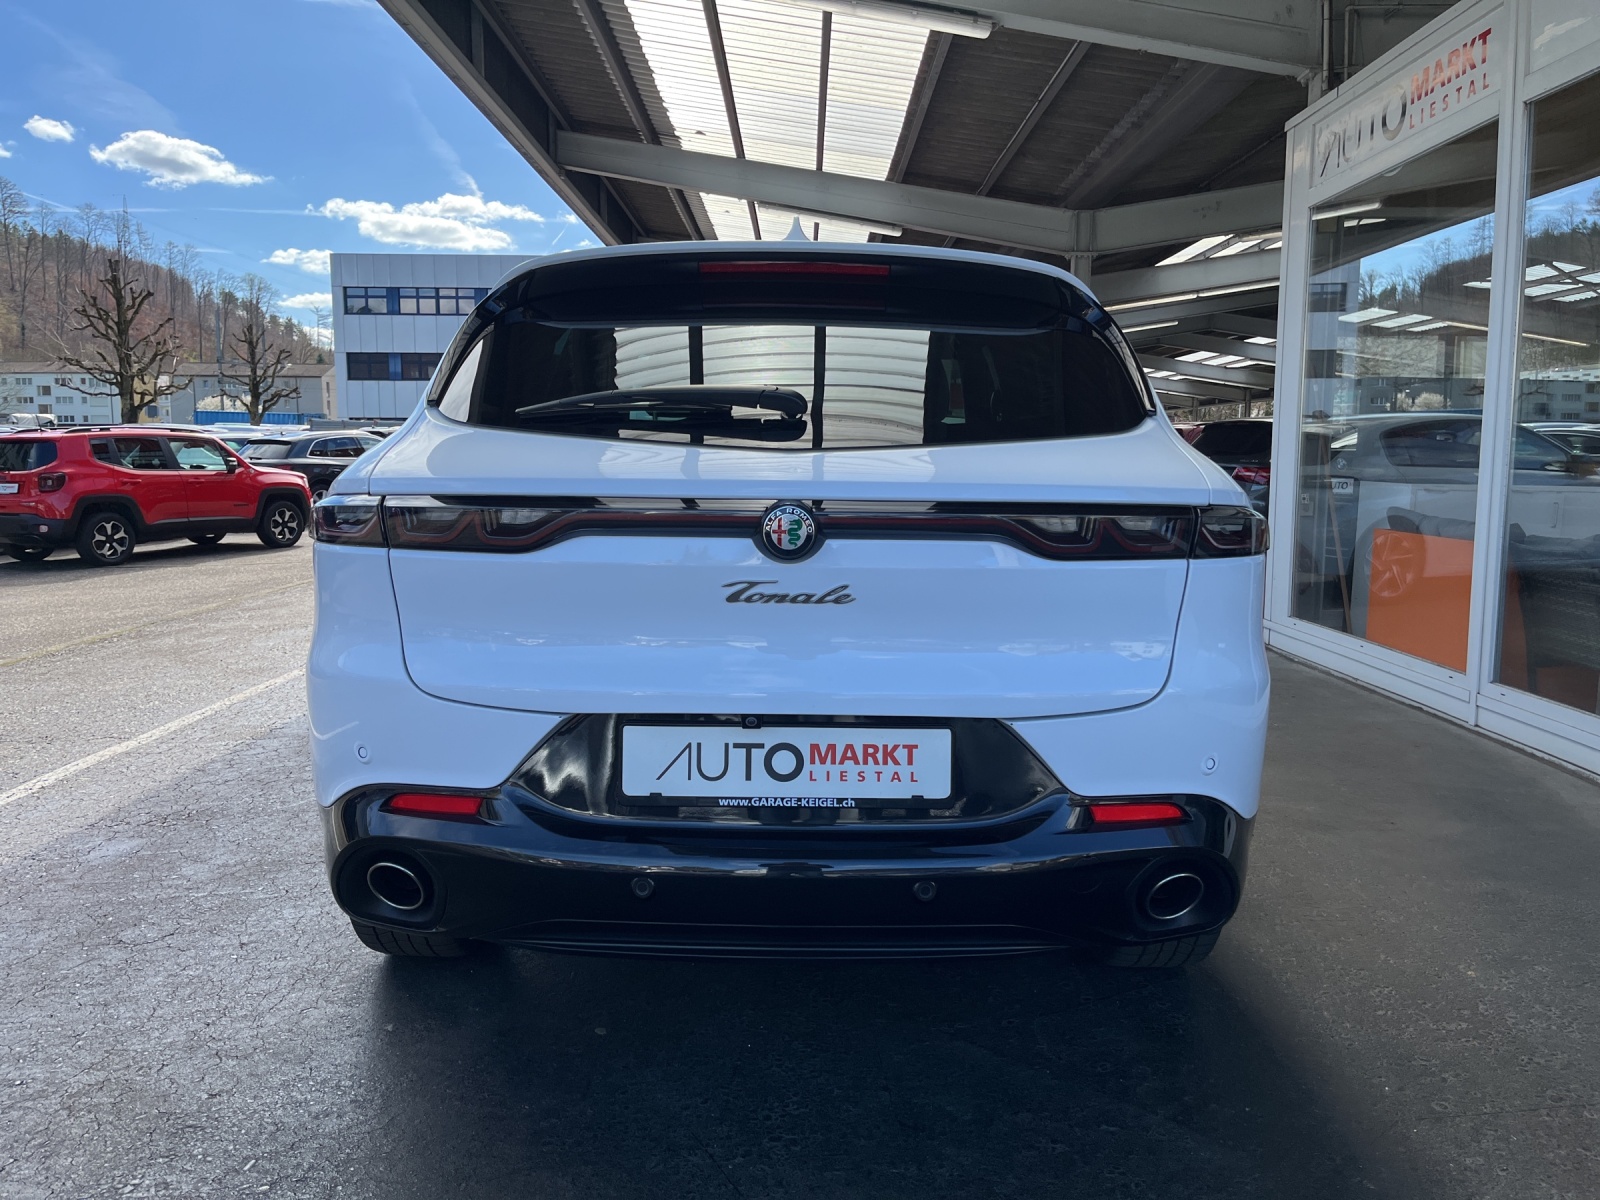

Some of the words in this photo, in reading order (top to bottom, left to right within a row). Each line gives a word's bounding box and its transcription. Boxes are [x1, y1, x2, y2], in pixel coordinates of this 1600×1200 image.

[1319, 86, 1408, 178] AUTO
[1410, 27, 1492, 106] MARKT
[1409, 72, 1490, 130] LIESTAL
[765, 510, 782, 532] ALFA
[786, 508, 813, 533] ROMEO
[721, 579, 857, 605] Tonale
[655, 741, 805, 783] AUTO
[809, 743, 919, 766] MARKT
[809, 770, 919, 783] LIESTAL
[718, 797, 856, 808] www.GARAGE-KEIGEL.ch
